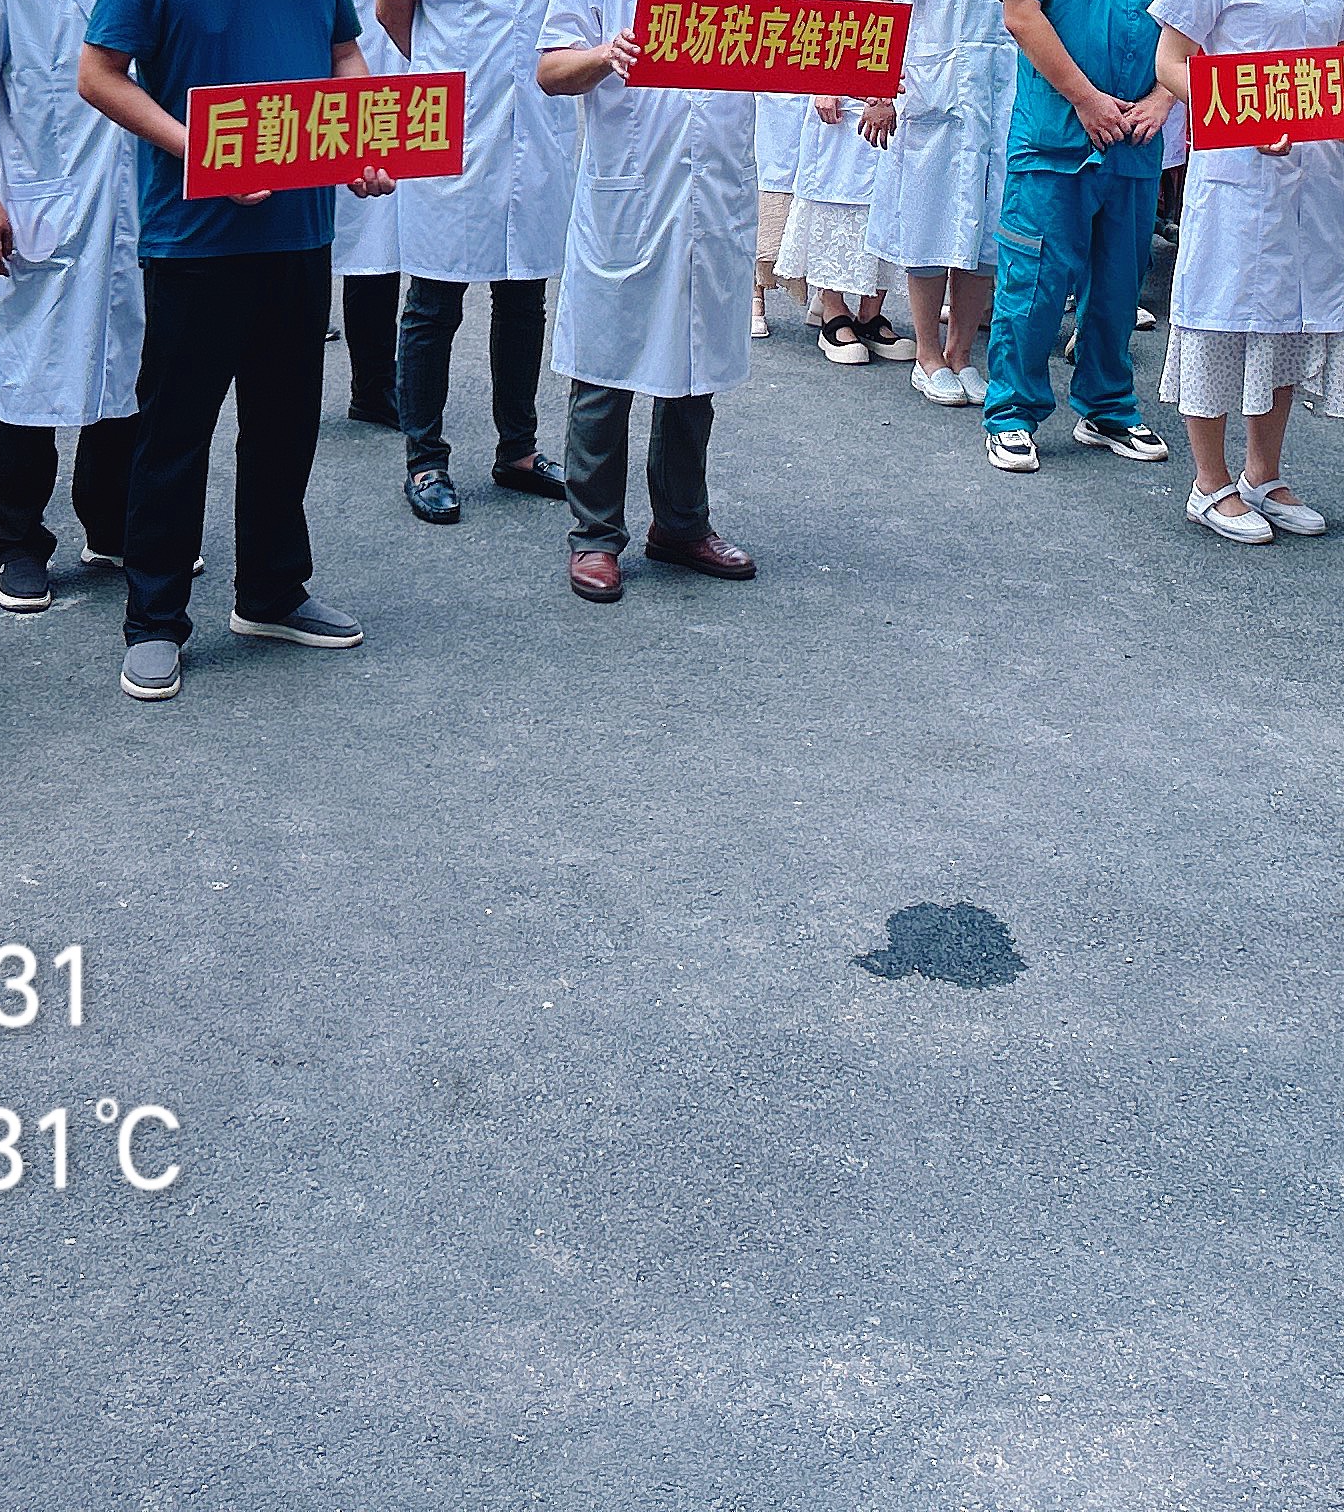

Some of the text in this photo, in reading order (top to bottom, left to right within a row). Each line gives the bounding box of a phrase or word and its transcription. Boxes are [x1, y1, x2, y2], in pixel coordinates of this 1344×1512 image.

[644, 2, 896, 73] 现场秩序维护组
[201, 85, 450, 170] 后勤保障组
